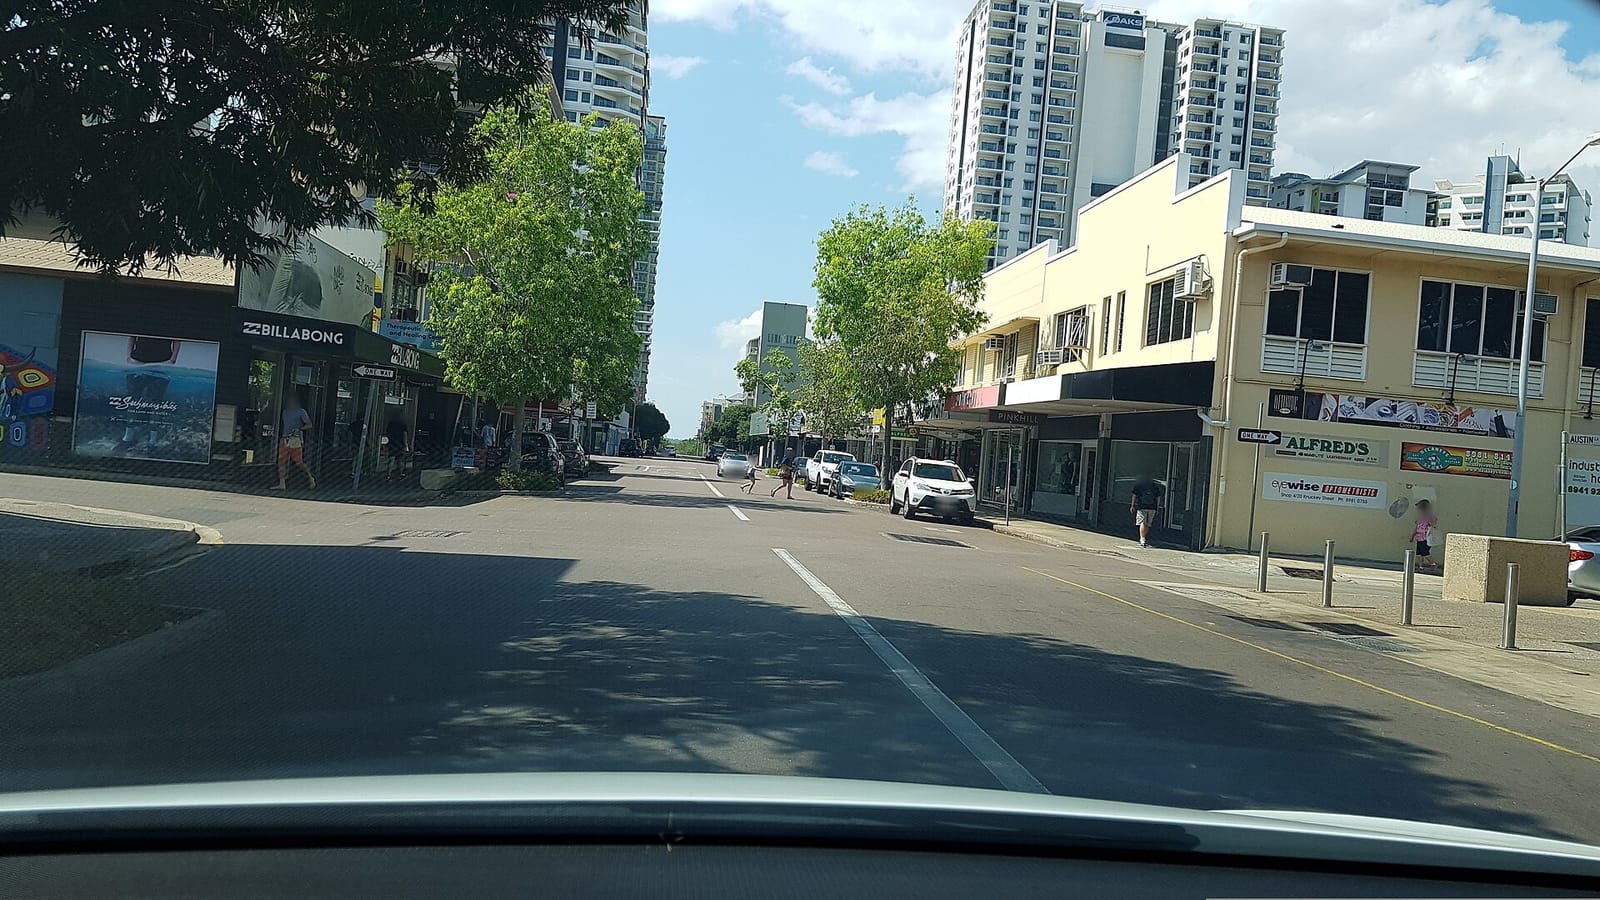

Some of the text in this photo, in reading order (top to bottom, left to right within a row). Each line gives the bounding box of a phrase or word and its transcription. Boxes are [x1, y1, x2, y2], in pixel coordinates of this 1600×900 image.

[1104, 14, 1143, 27] OAKS
[386, 322, 422, 332] Therapeutic
[261, 323, 344, 345] BILLABONG
[998, 412, 1039, 424] PINKHILL
[1570, 435, 1594, 444] AUSTIN
[1286, 437, 1369, 455] ALFRED'S
[1271, 479, 1320, 493] eyewise
[1568, 486, 1588, 495] 8941
